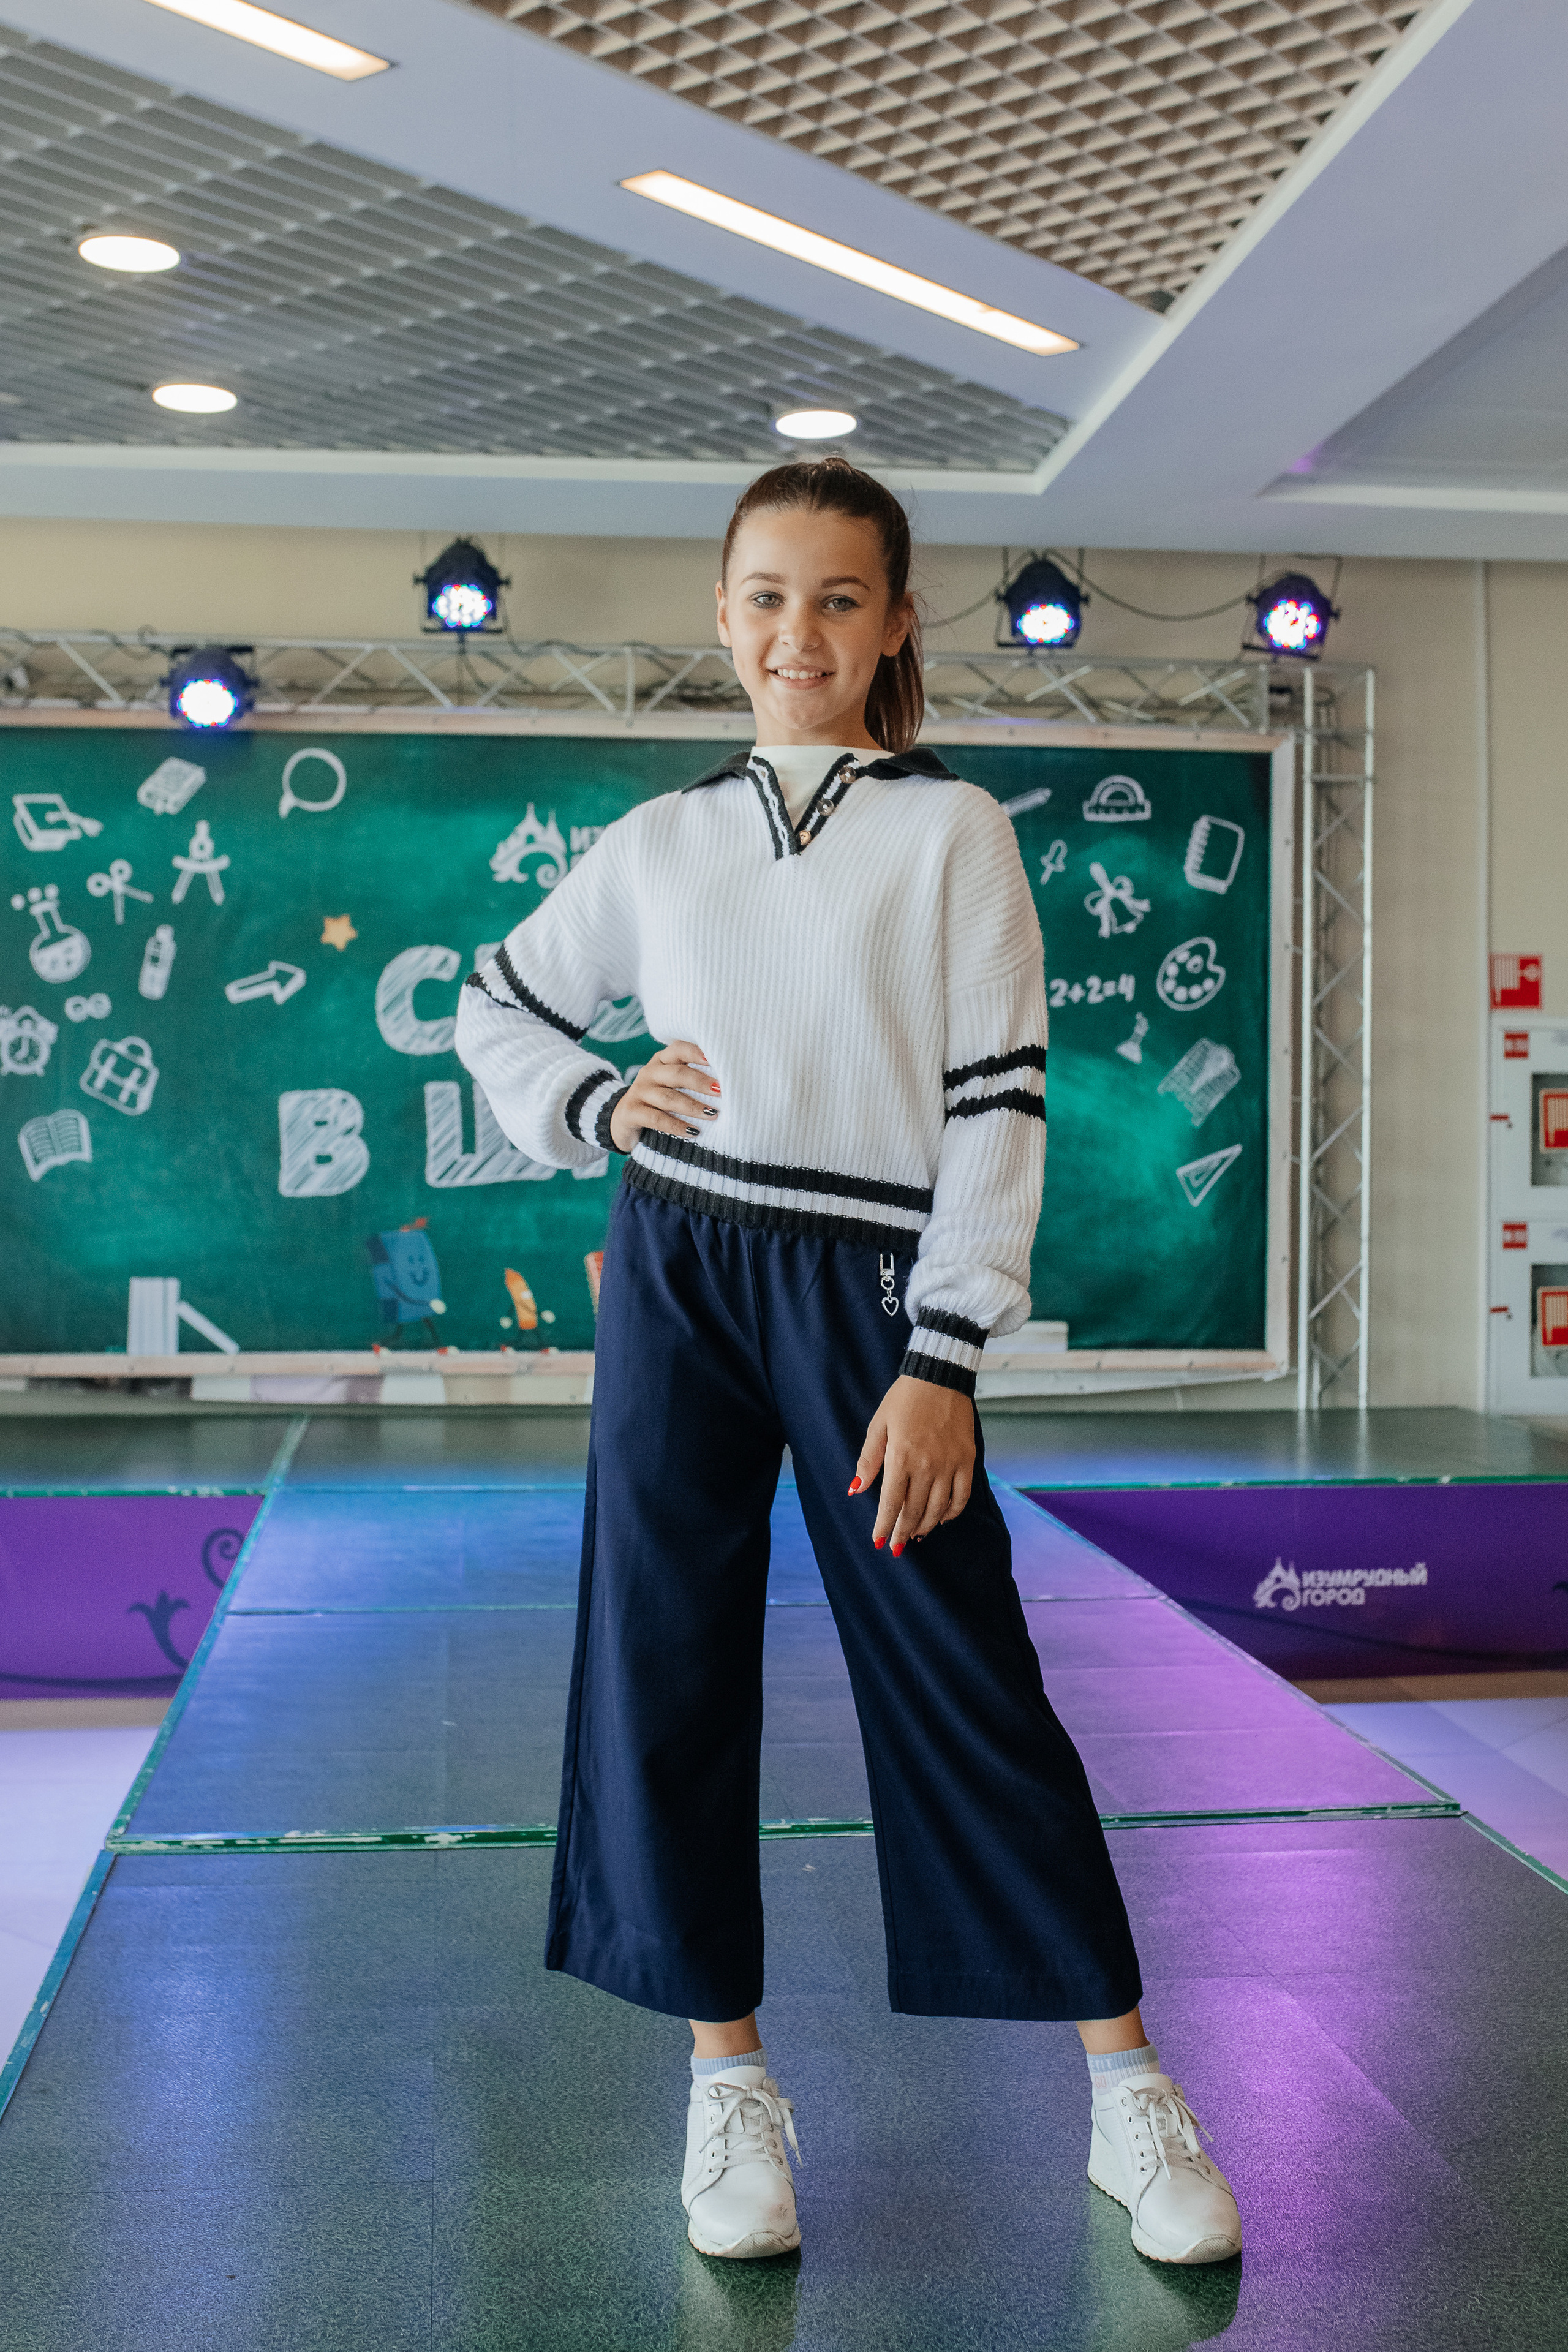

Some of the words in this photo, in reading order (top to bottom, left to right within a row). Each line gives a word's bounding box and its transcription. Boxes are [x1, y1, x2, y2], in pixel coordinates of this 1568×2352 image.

[1049, 973, 1135, 1008] 2+2=4
[1302, 1562, 1428, 1588] ИЗУМРУДНЫЙ
[1302, 1588, 1365, 1606] ГОРОД
